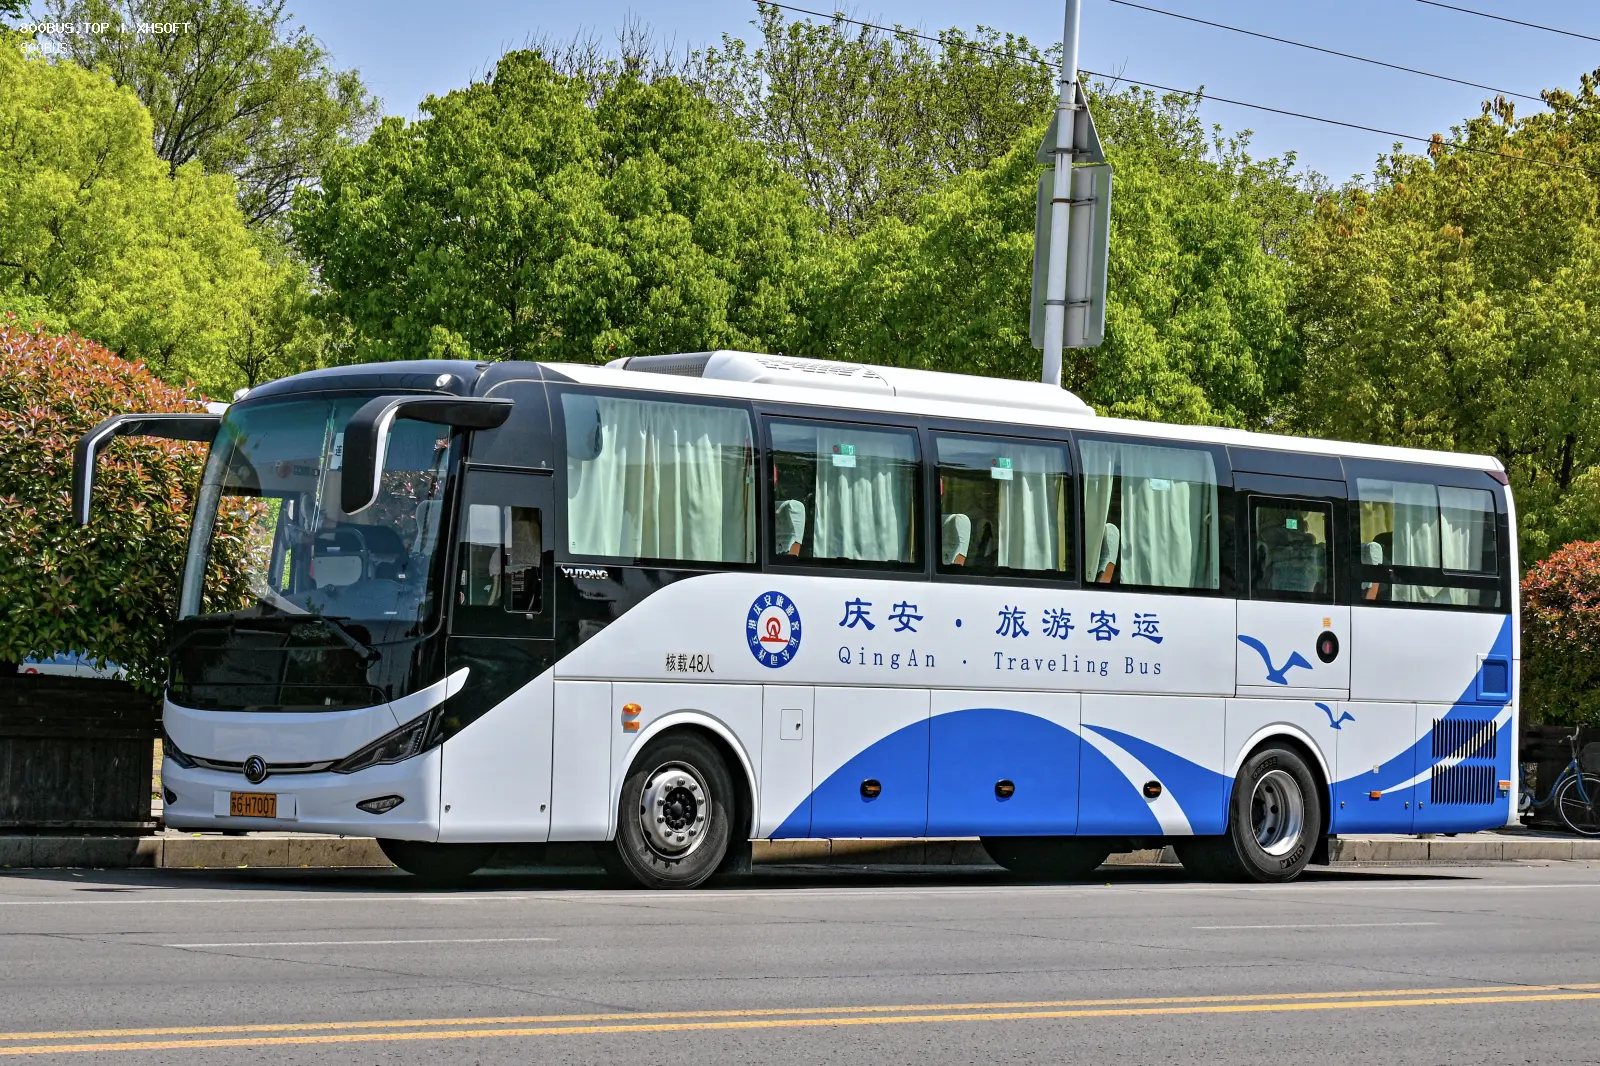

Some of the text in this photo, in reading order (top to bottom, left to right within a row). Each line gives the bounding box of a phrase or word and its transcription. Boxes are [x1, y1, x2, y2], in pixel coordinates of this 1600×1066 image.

[561, 566, 609, 580] YUTONG
[665, 653, 715, 673] 核载48人
[838, 646, 936, 670] QingAn
[993, 651, 1109, 677] Traveling
[1124, 656, 1162, 675] Bus
